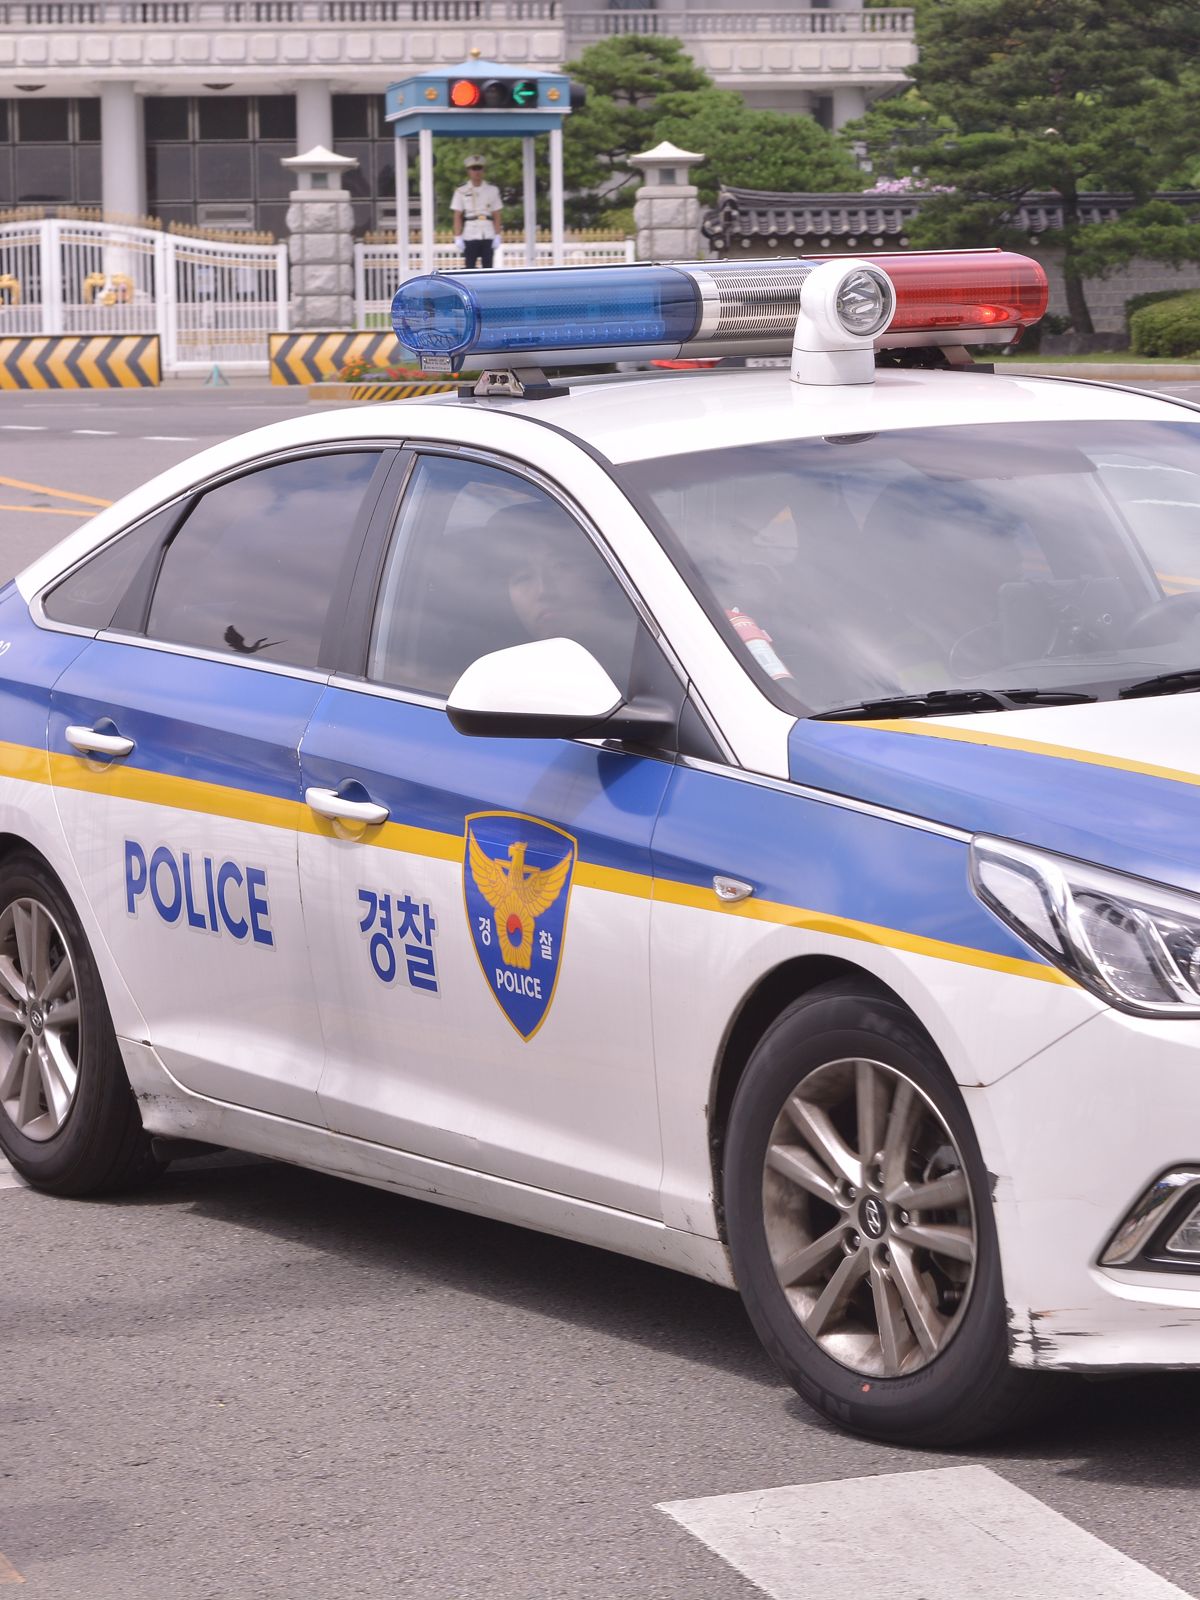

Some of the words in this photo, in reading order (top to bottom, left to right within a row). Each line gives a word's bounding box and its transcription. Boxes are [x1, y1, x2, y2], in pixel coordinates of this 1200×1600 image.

[126, 838, 273, 946] POLICE
[358, 888, 439, 993] 경찰
[478, 916, 491, 946] 경
[539, 929, 553, 960] 찰
[495, 967, 542, 1000] POLICE
